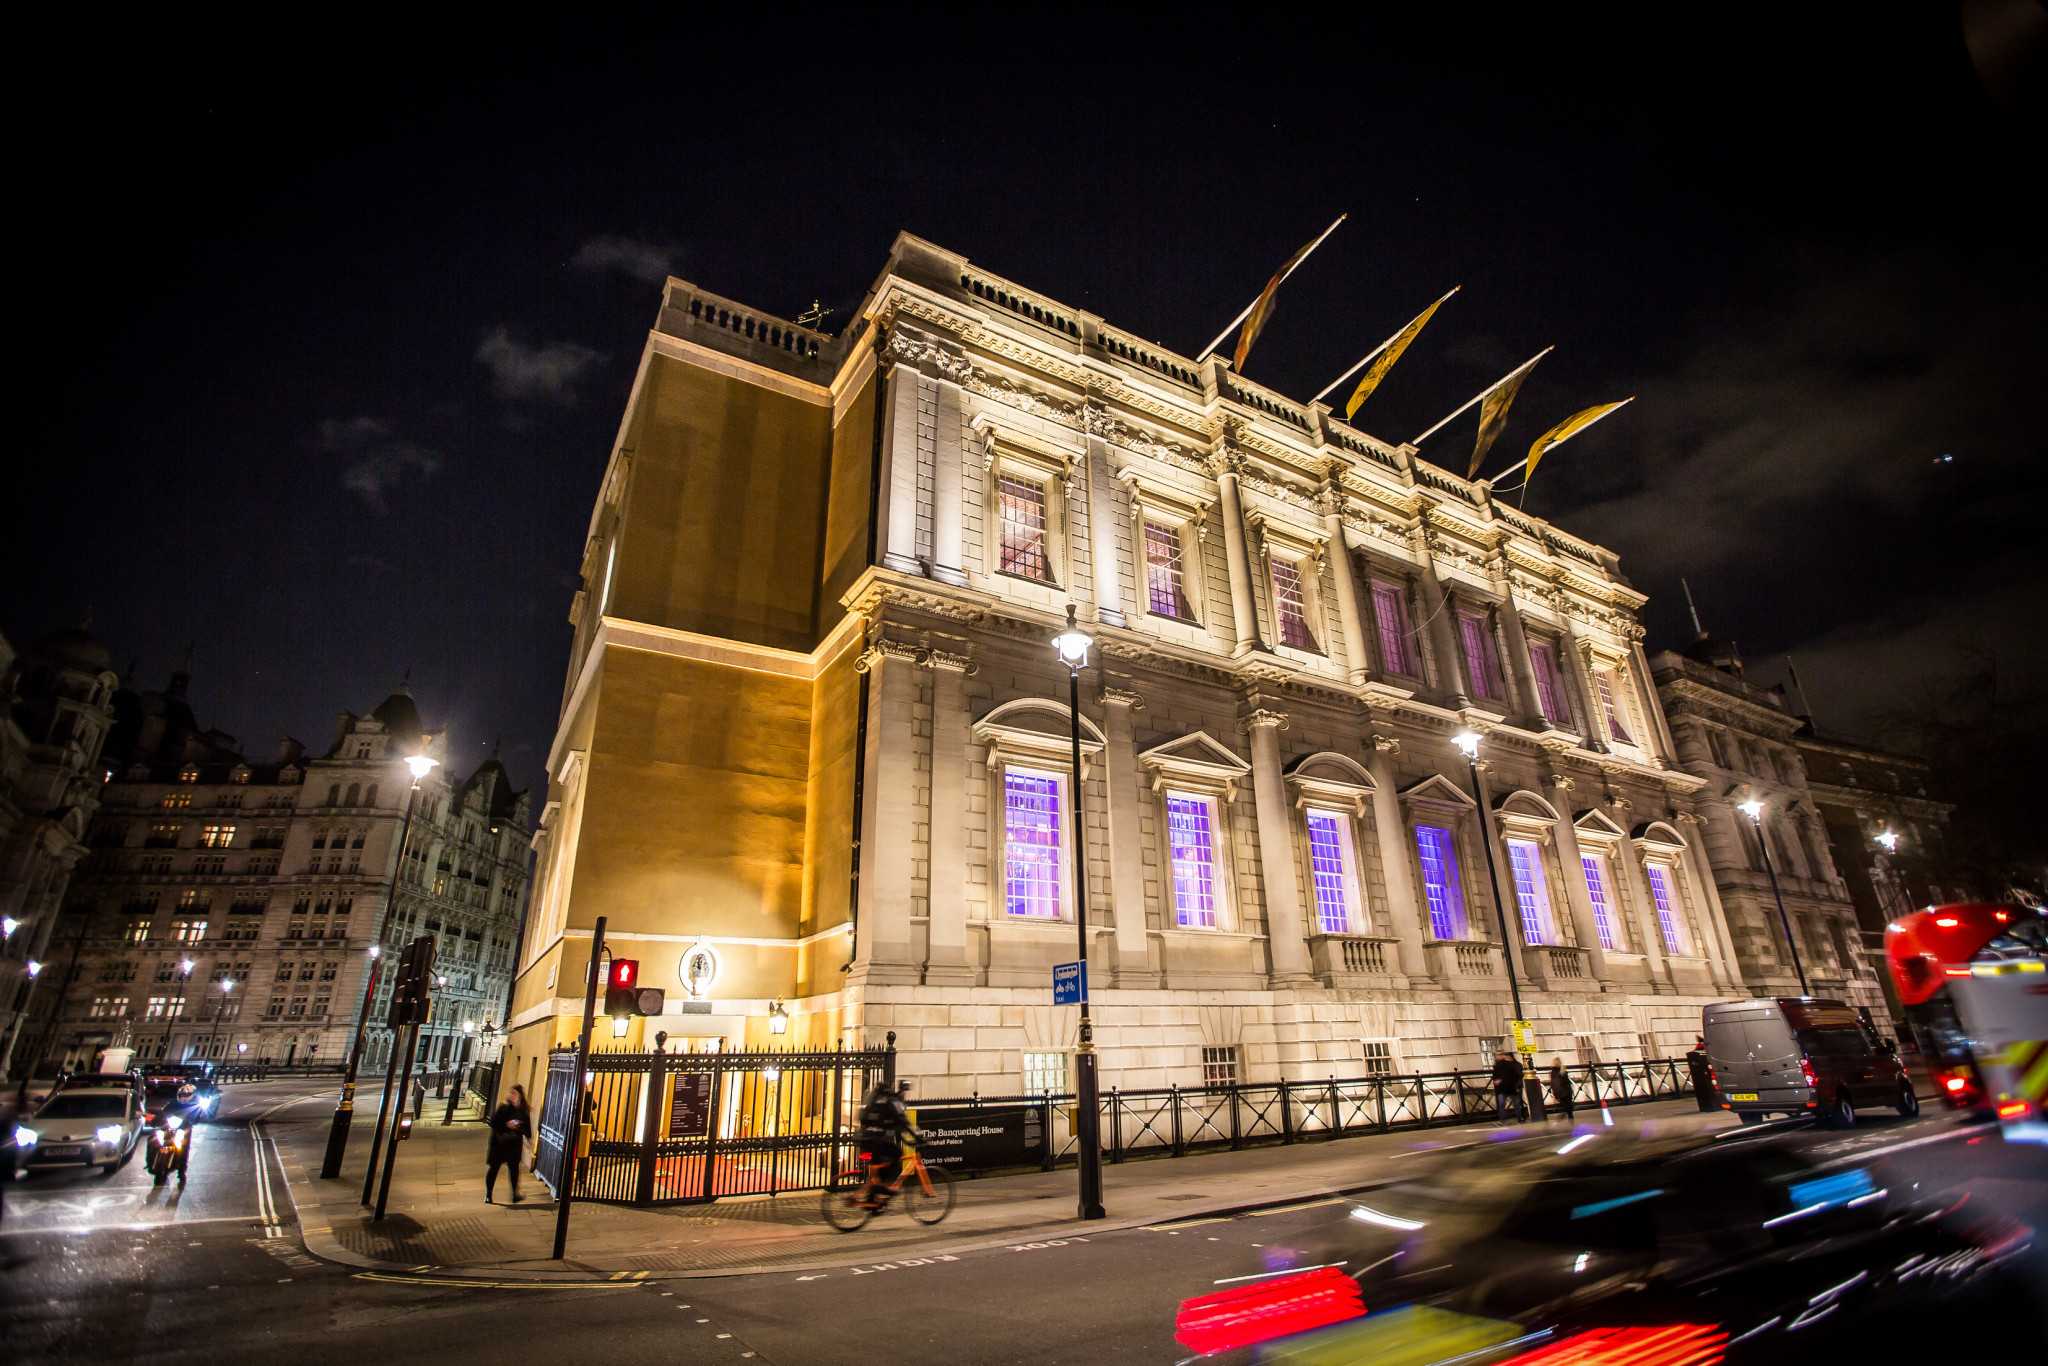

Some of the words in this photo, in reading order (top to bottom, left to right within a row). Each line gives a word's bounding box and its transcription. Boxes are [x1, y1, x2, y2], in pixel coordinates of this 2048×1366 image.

[922, 1129, 936, 1138] The
[938, 1127, 981, 1138] Banqueting
[981, 1126, 1004, 1135] House
[1005, 1237, 1090, 1252] LOOK
[851, 1254, 960, 1275] RIGHT
